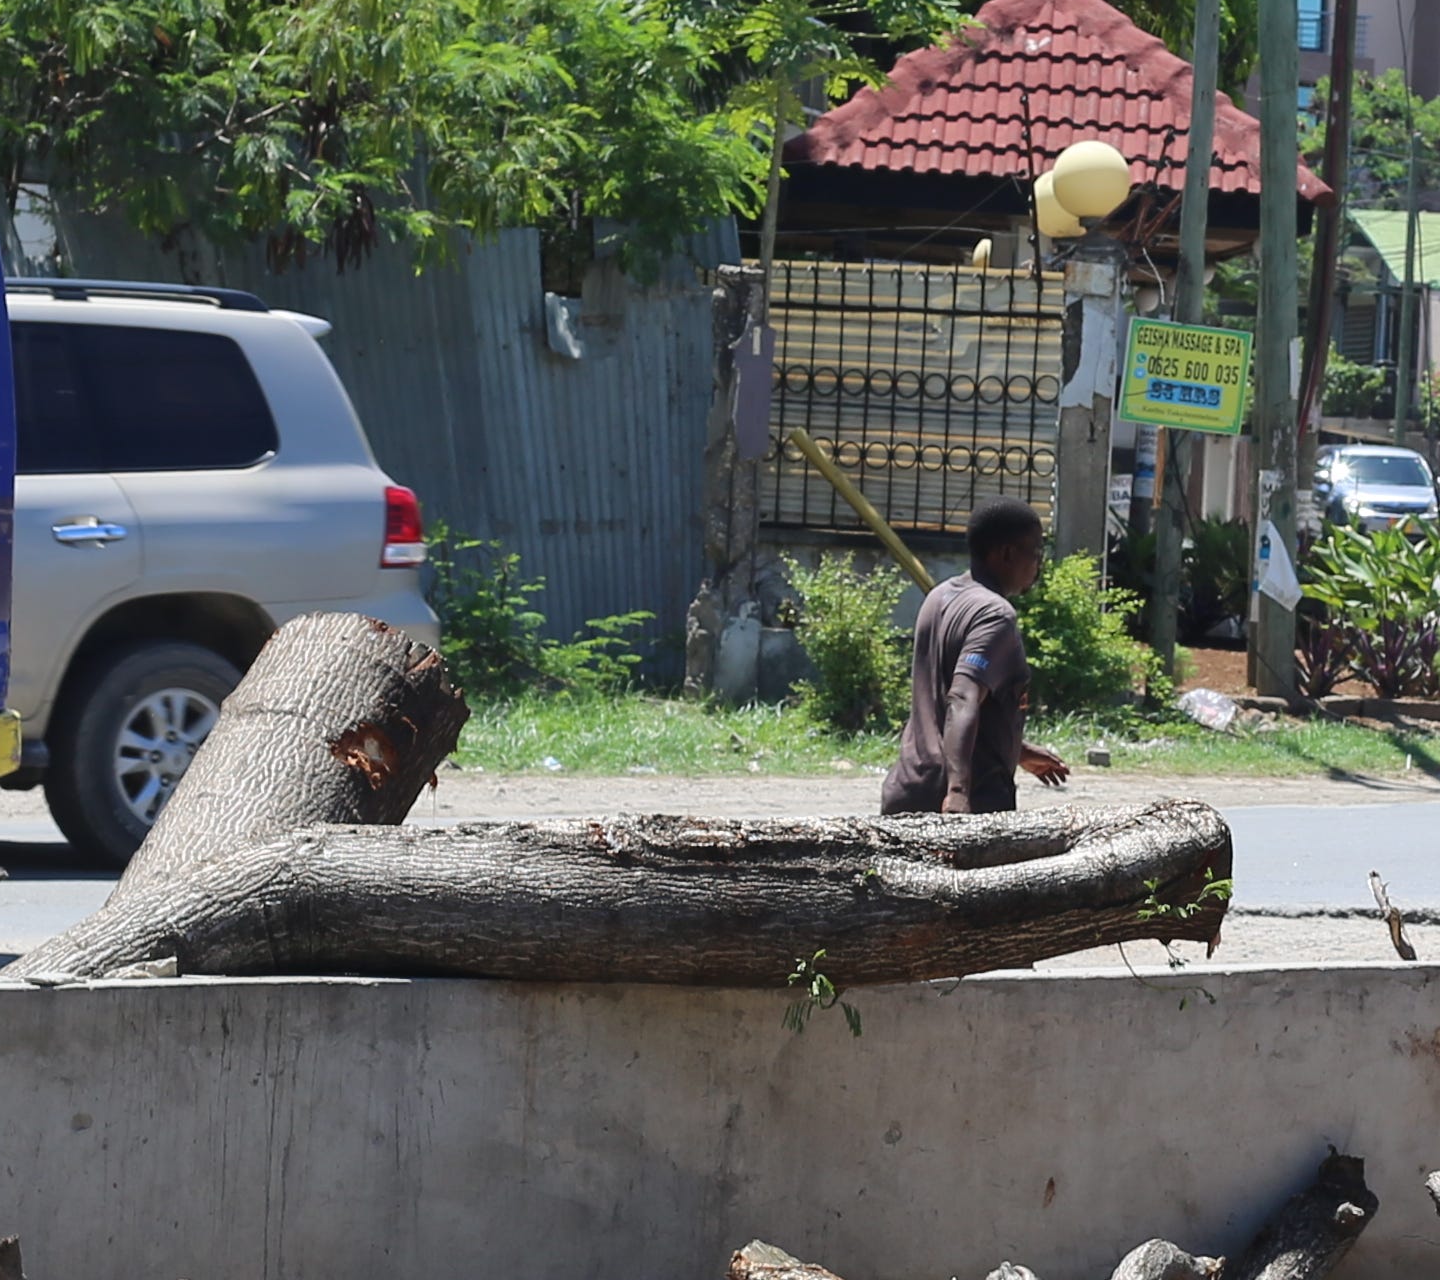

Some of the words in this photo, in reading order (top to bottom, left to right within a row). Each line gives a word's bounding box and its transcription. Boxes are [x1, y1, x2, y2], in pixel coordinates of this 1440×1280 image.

[1137, 327, 1170, 348] GEISHA
[1172, 330, 1213, 354] MASSAGE
[1215, 337, 1222, 355] &
[1223, 338, 1241, 357] SPA
[1148, 356, 1179, 377] 0625
[1185, 361, 1209, 382] 600
[1215, 365, 1239, 385] 035
